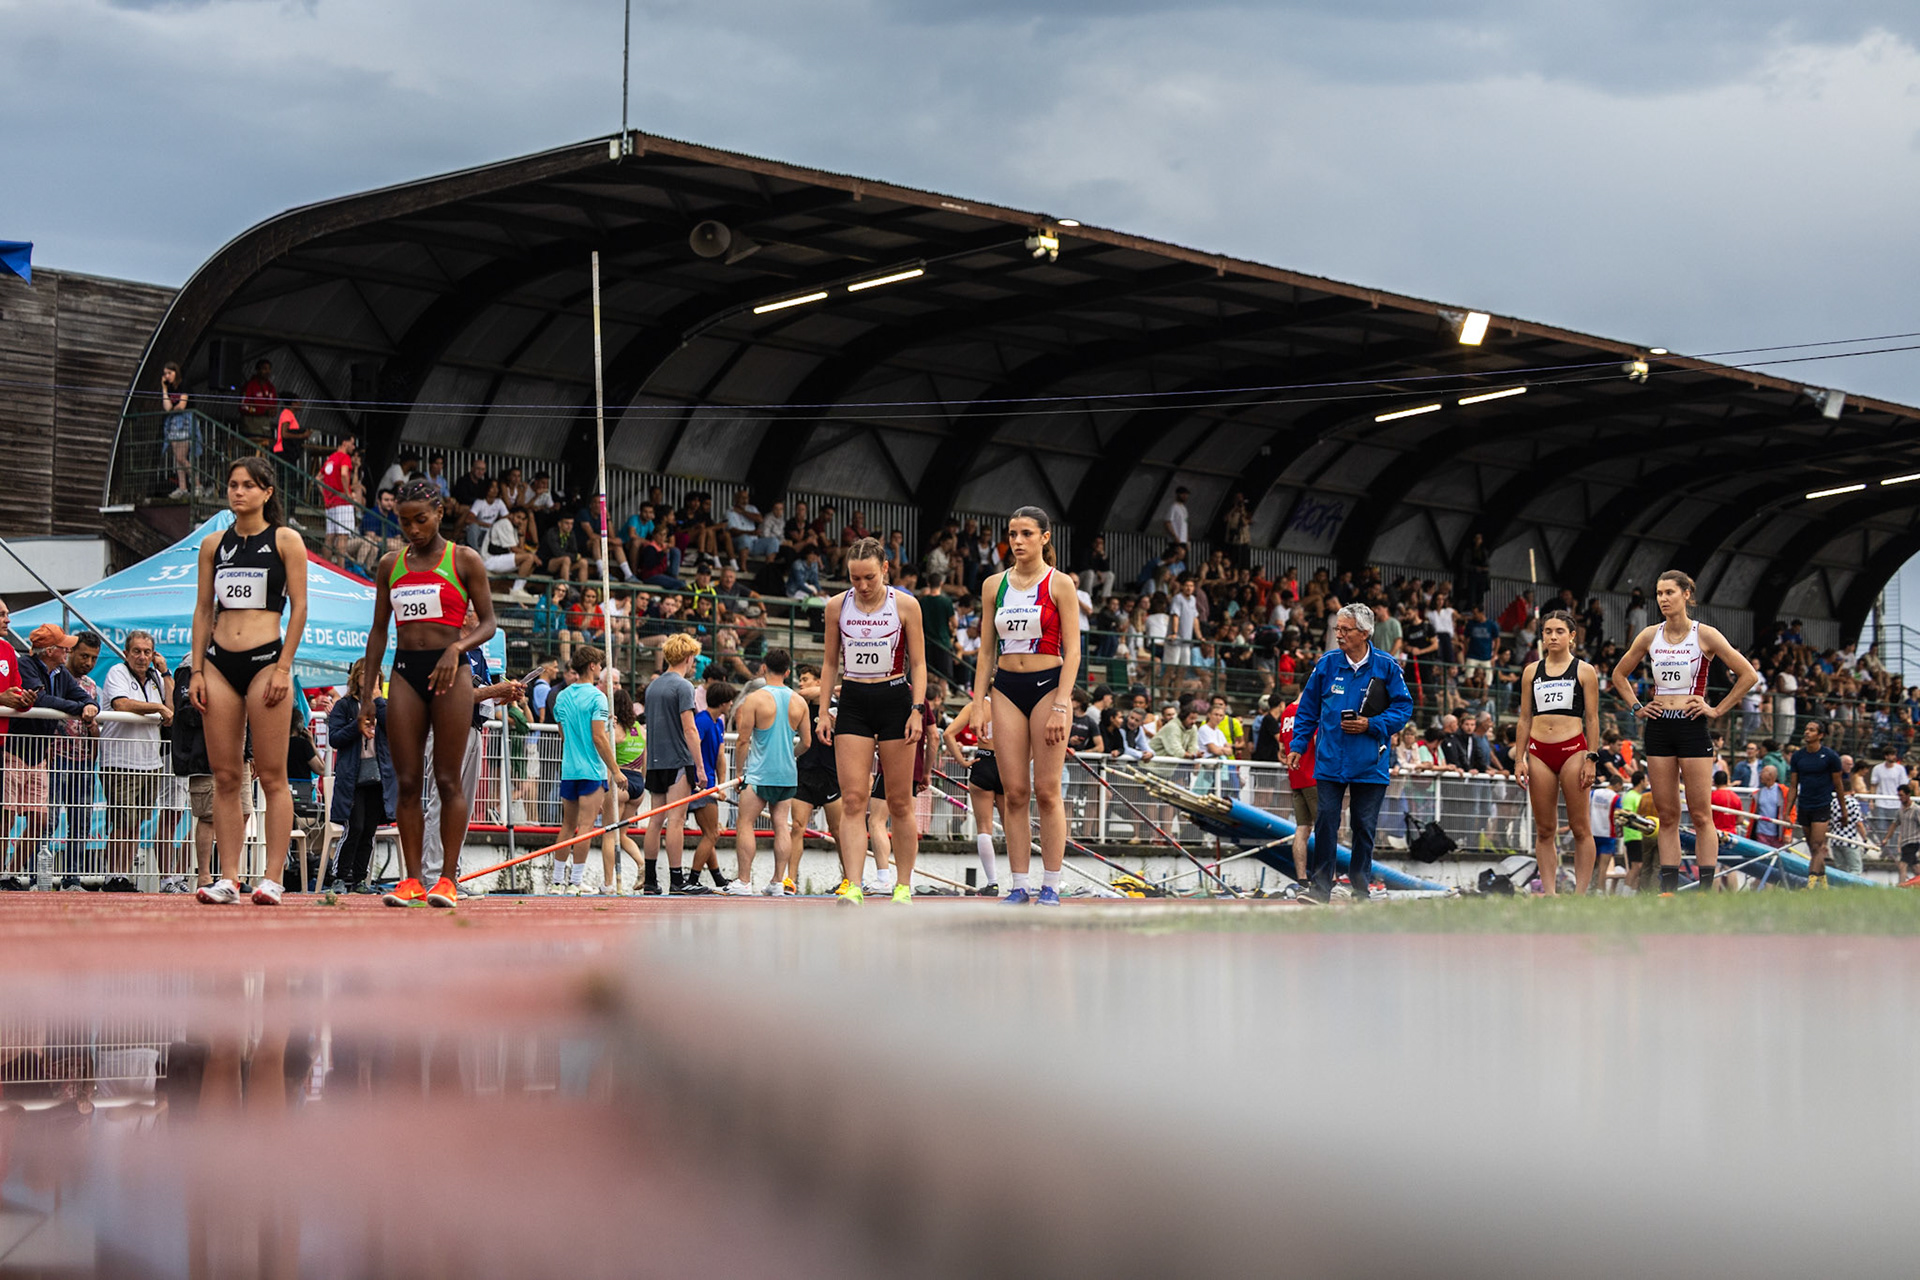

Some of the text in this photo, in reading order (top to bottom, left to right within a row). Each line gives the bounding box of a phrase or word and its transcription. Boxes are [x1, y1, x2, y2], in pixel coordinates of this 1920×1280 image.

[148, 563, 197, 581] 33
[226, 585, 252, 598] 268
[401, 588, 436, 597] DECATHLON
[402, 602, 427, 617] 298
[1006, 619, 1028, 631] 277
[315, 627, 334, 645] DE
[855, 653, 879, 664] 270
[1661, 671, 1680, 681] 276
[1544, 692, 1563, 703] 275
